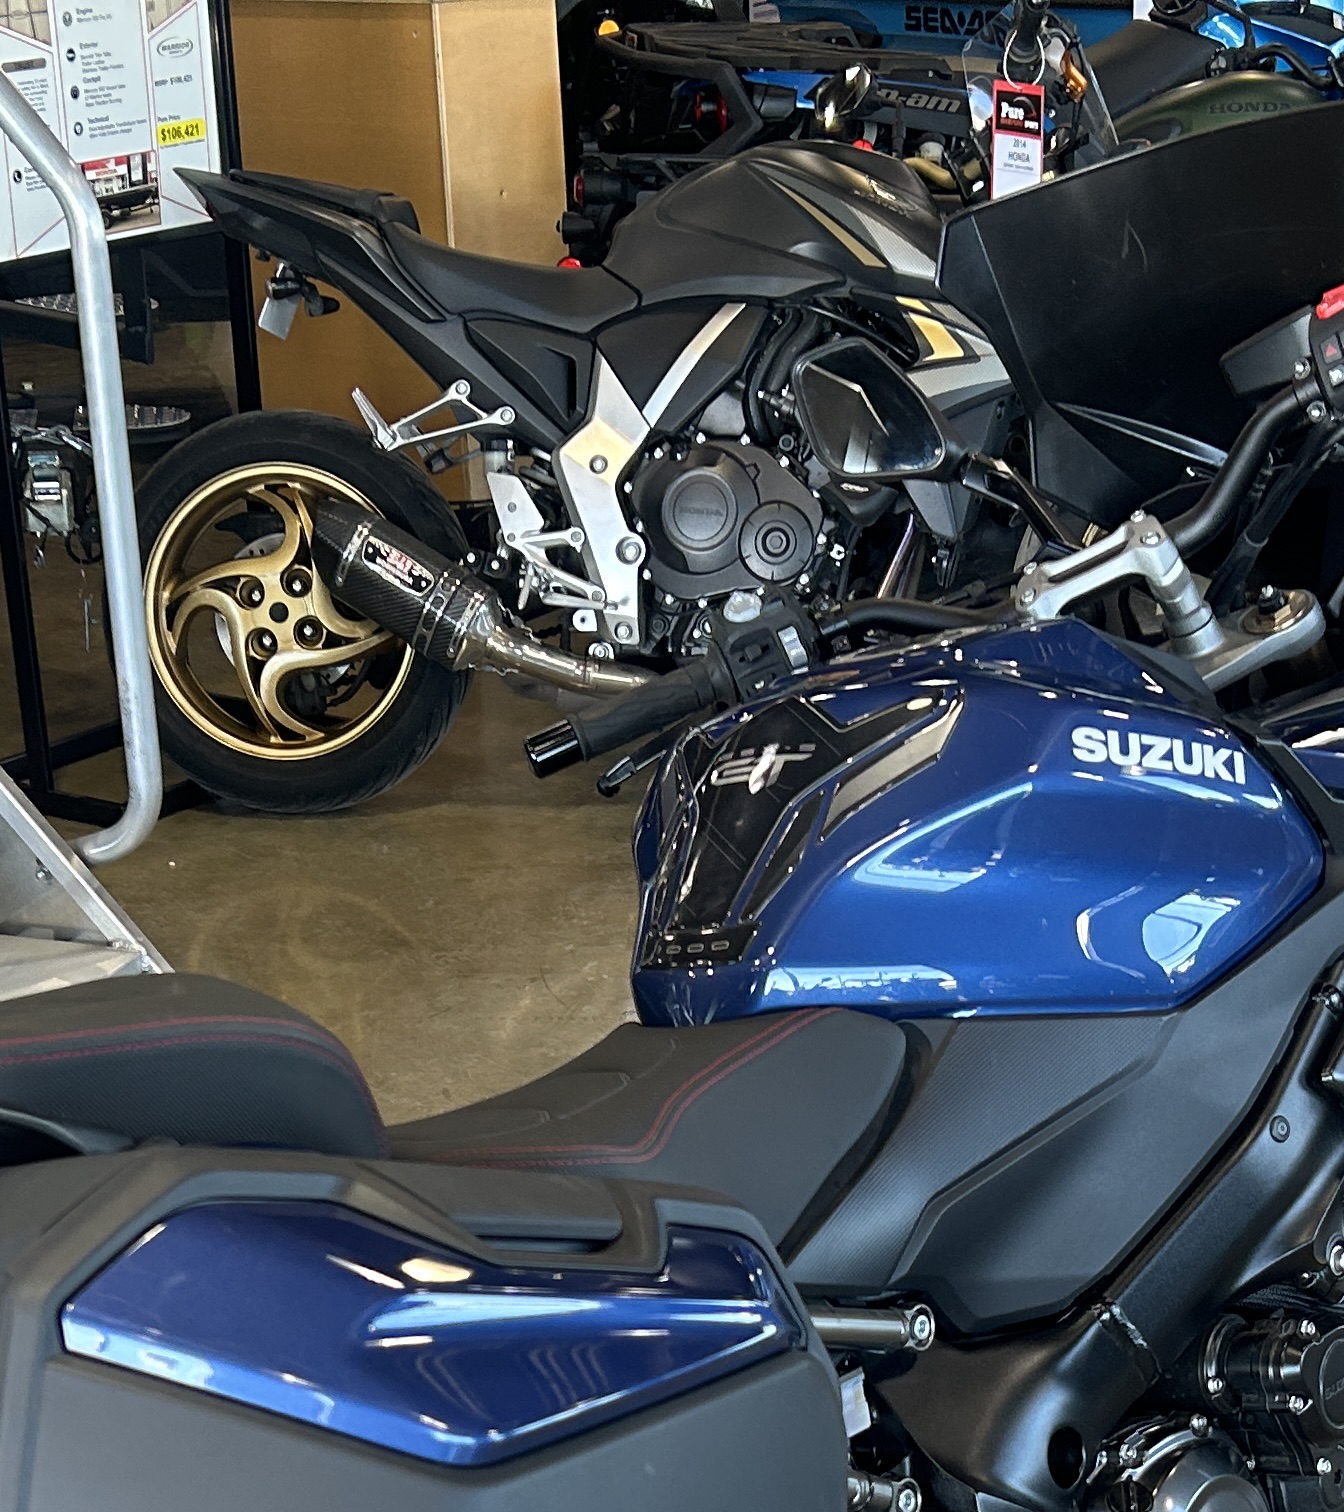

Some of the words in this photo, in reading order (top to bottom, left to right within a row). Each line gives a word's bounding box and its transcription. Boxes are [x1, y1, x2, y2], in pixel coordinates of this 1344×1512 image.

[1001, 101, 1025, 120] Pure
[161, 123, 199, 142] $106,421
[1071, 725, 1247, 786] SUZUKI
